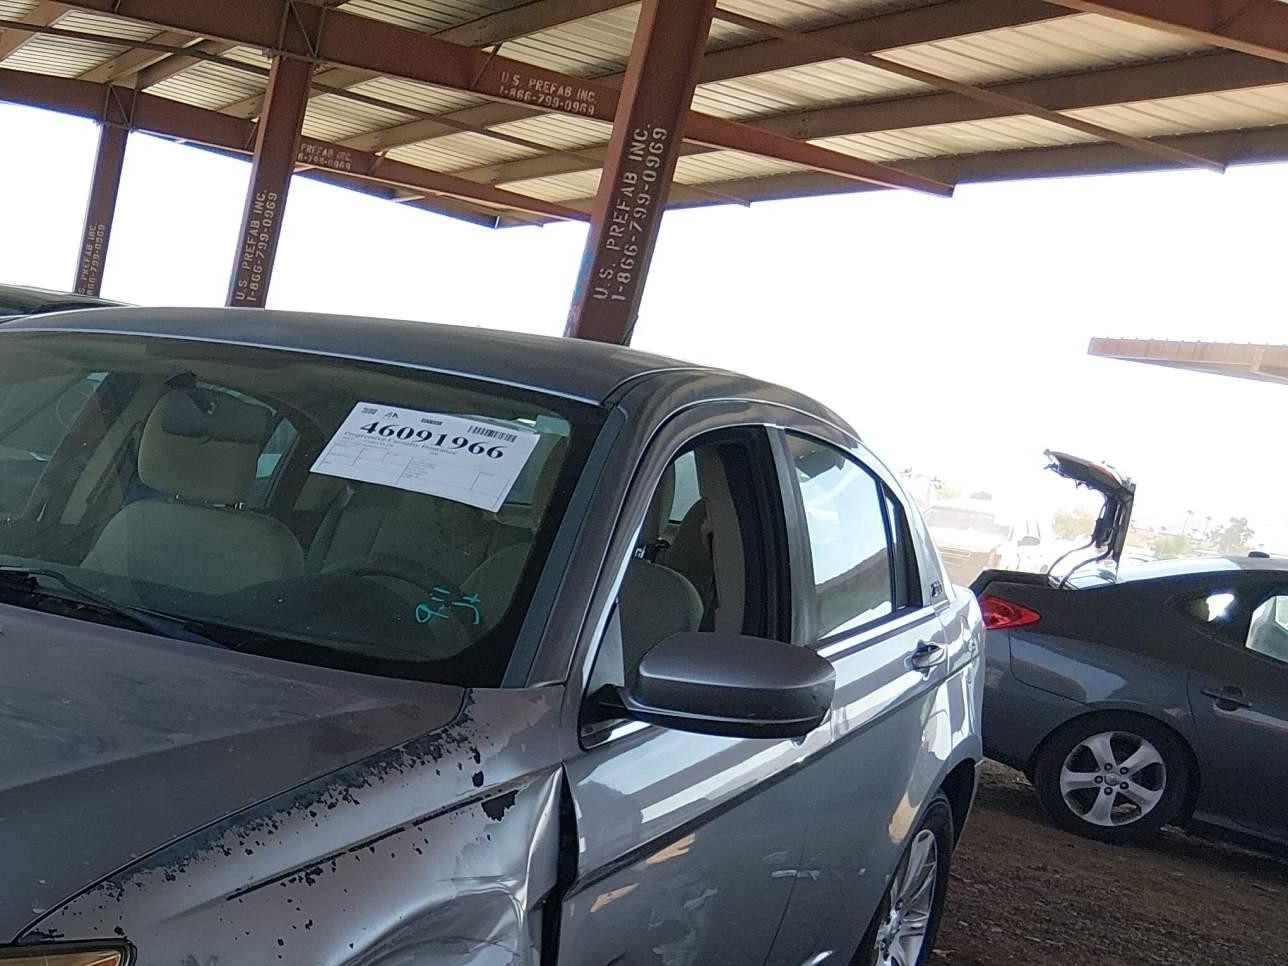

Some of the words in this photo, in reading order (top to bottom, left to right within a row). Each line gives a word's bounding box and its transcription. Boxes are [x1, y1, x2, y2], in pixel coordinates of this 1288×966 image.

[499, 85, 596, 115] 1-866-799-0969
[528, 79, 573, 98] PREFAB
[576, 89, 598, 104] INC.
[593, 262, 617, 300] U.S.
[605, 171, 638, 251] PREFAB
[629, 123, 651, 162] INC.
[611, 127, 667, 301] 1-866-799-0969
[242, 220, 260, 270] PREFAB
[247, 192, 278, 302] 1-866-799-0969
[360, 420, 507, 460] 46091966
